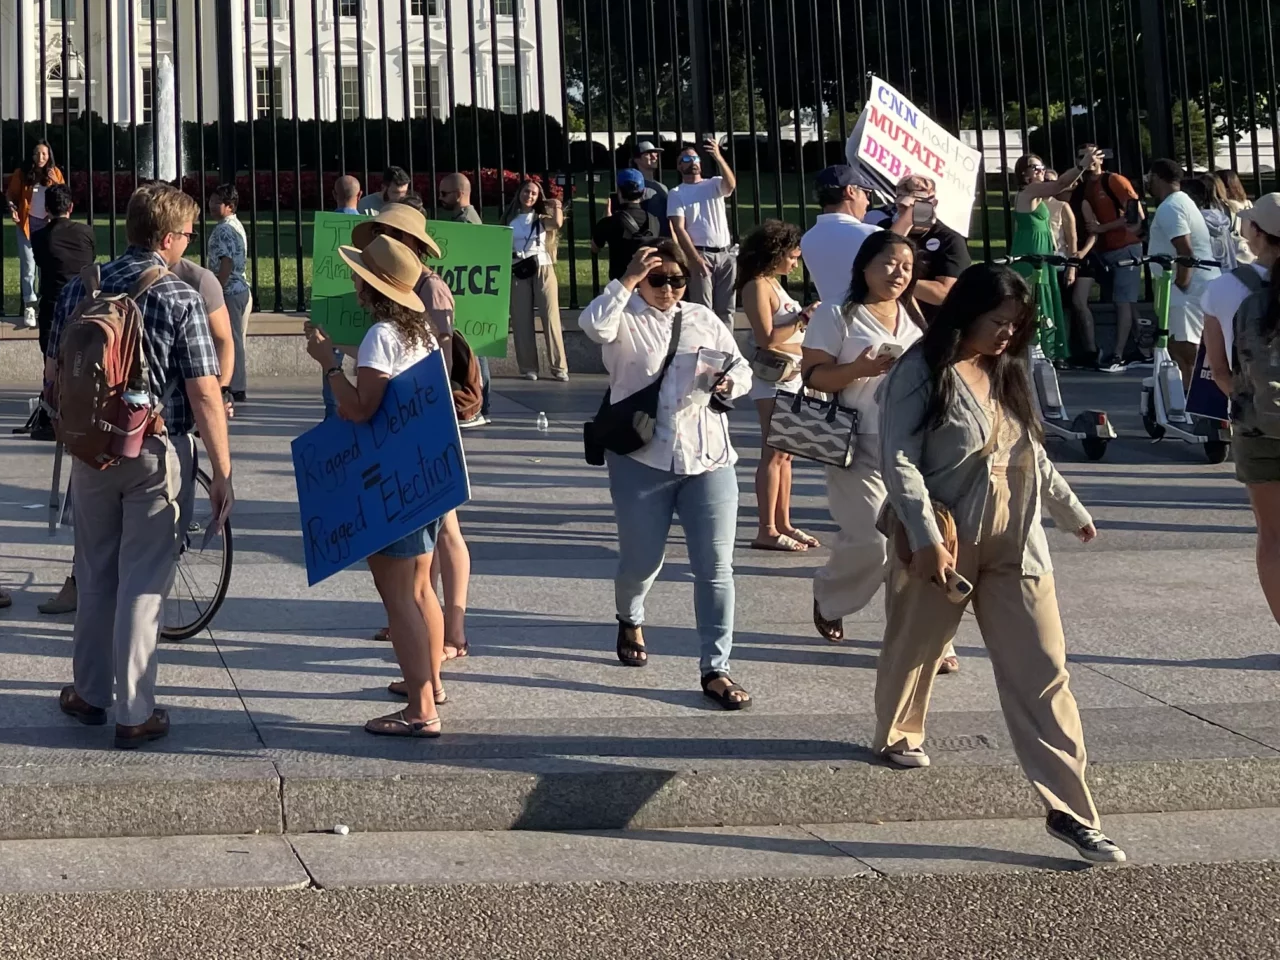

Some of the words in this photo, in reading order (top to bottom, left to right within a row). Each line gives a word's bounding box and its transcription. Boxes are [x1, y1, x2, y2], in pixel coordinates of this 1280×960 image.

[868, 105, 946, 178] MUTATE
[877, 85, 918, 129] CNN
[921, 119, 950, 153] had
[299, 429, 362, 493] Rigged
[368, 375, 439, 449] Debate
[308, 508, 368, 568] Rigged
[379, 442, 464, 523] Election
